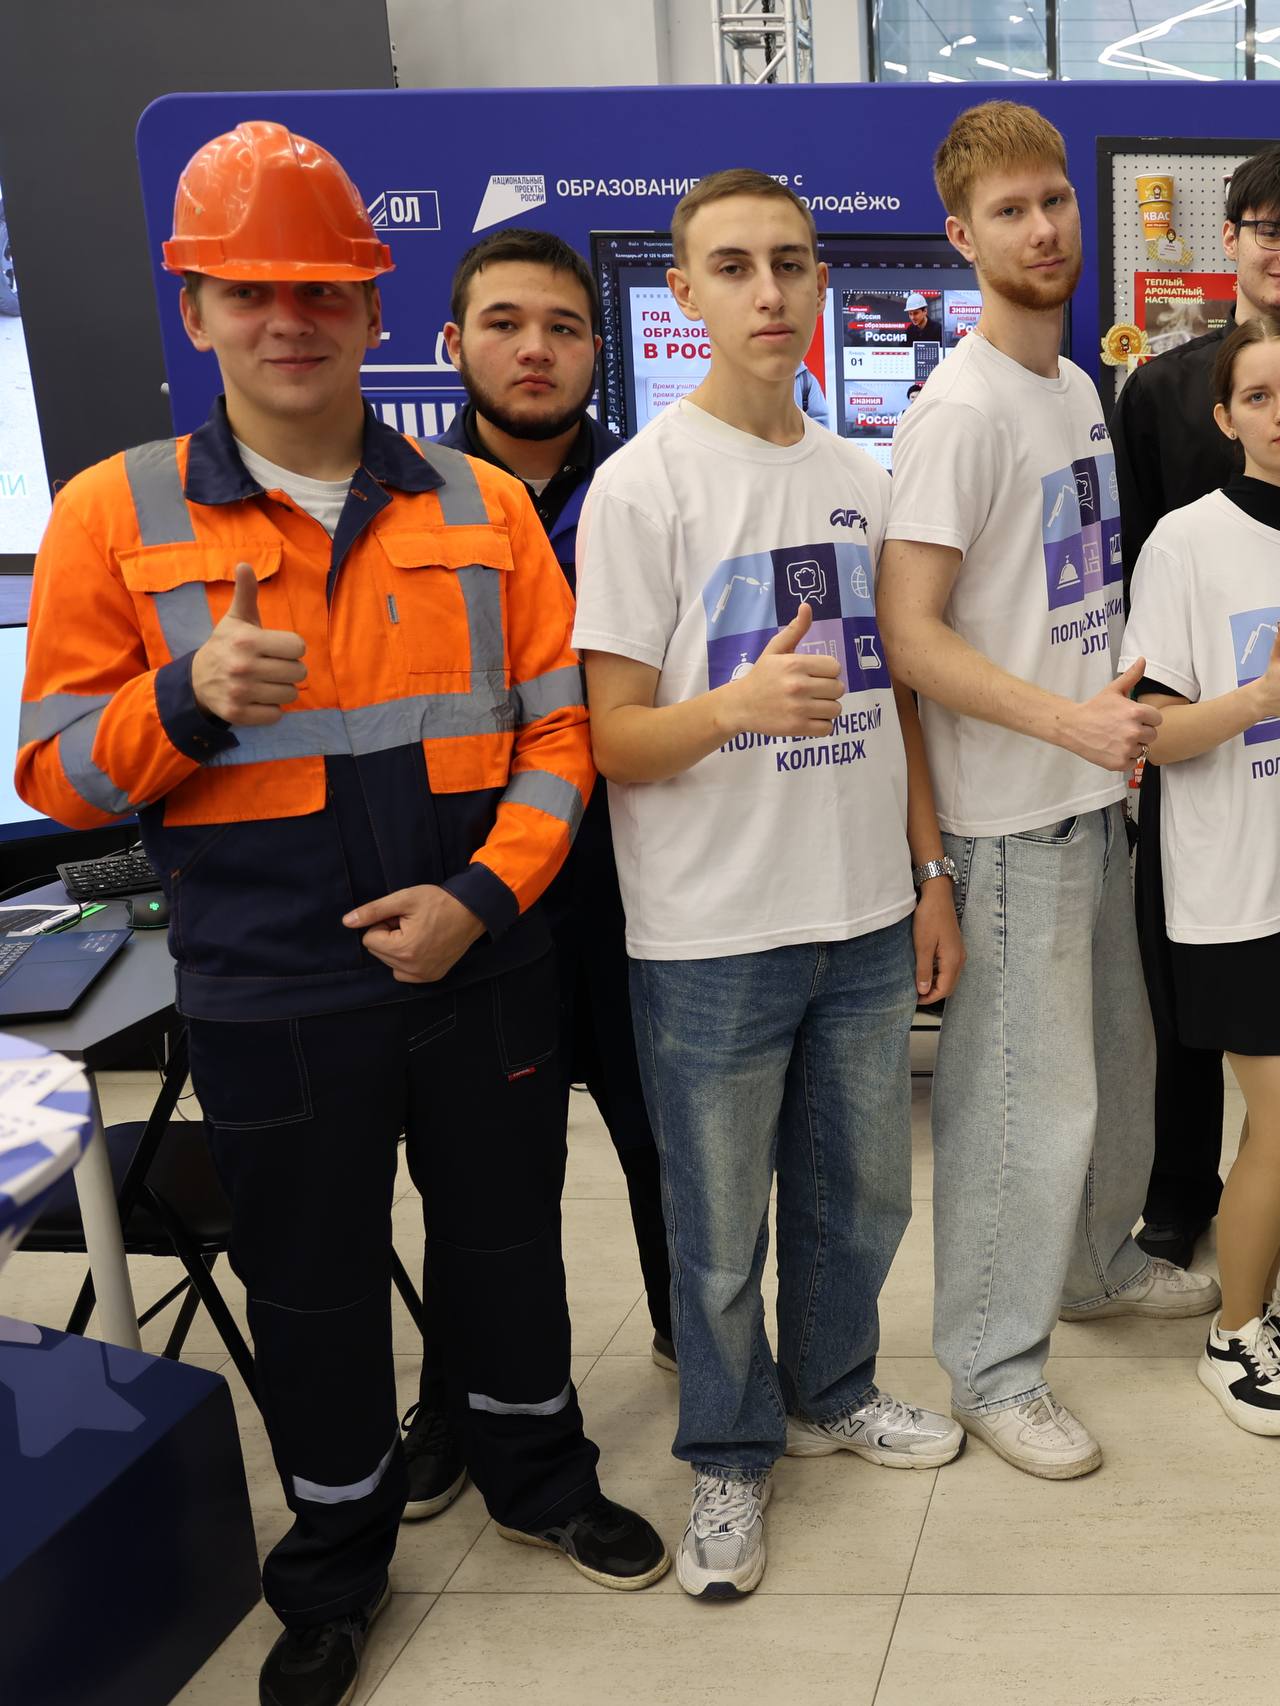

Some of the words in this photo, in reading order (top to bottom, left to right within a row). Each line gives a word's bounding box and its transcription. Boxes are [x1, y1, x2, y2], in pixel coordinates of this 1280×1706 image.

[492, 176, 544, 185] НАЦИОНАЛЬНЫЕ
[514, 185, 545, 193] ПРОЕКТЫ
[520, 194, 545, 202] РОССИИ
[799, 193, 901, 214] олодёжь
[1143, 211, 1171, 221] КВАС
[1144, 278, 1185, 287] ТЕПЛЫЙ.
[1144, 287, 1205, 296] АРОМАТНЫЙ.
[1144, 296, 1206, 305] НАСТОЯЩИЙ.
[642, 311, 671, 323] ГОД
[643, 327, 709, 338] ОБРАЗОВ
[865, 332, 908, 342] Россия
[643, 343, 658, 360] В
[666, 343, 712, 360] РОС
[850, 358, 863, 366] 01
[776, 739, 867, 772] КОЛЛЕДЖ
